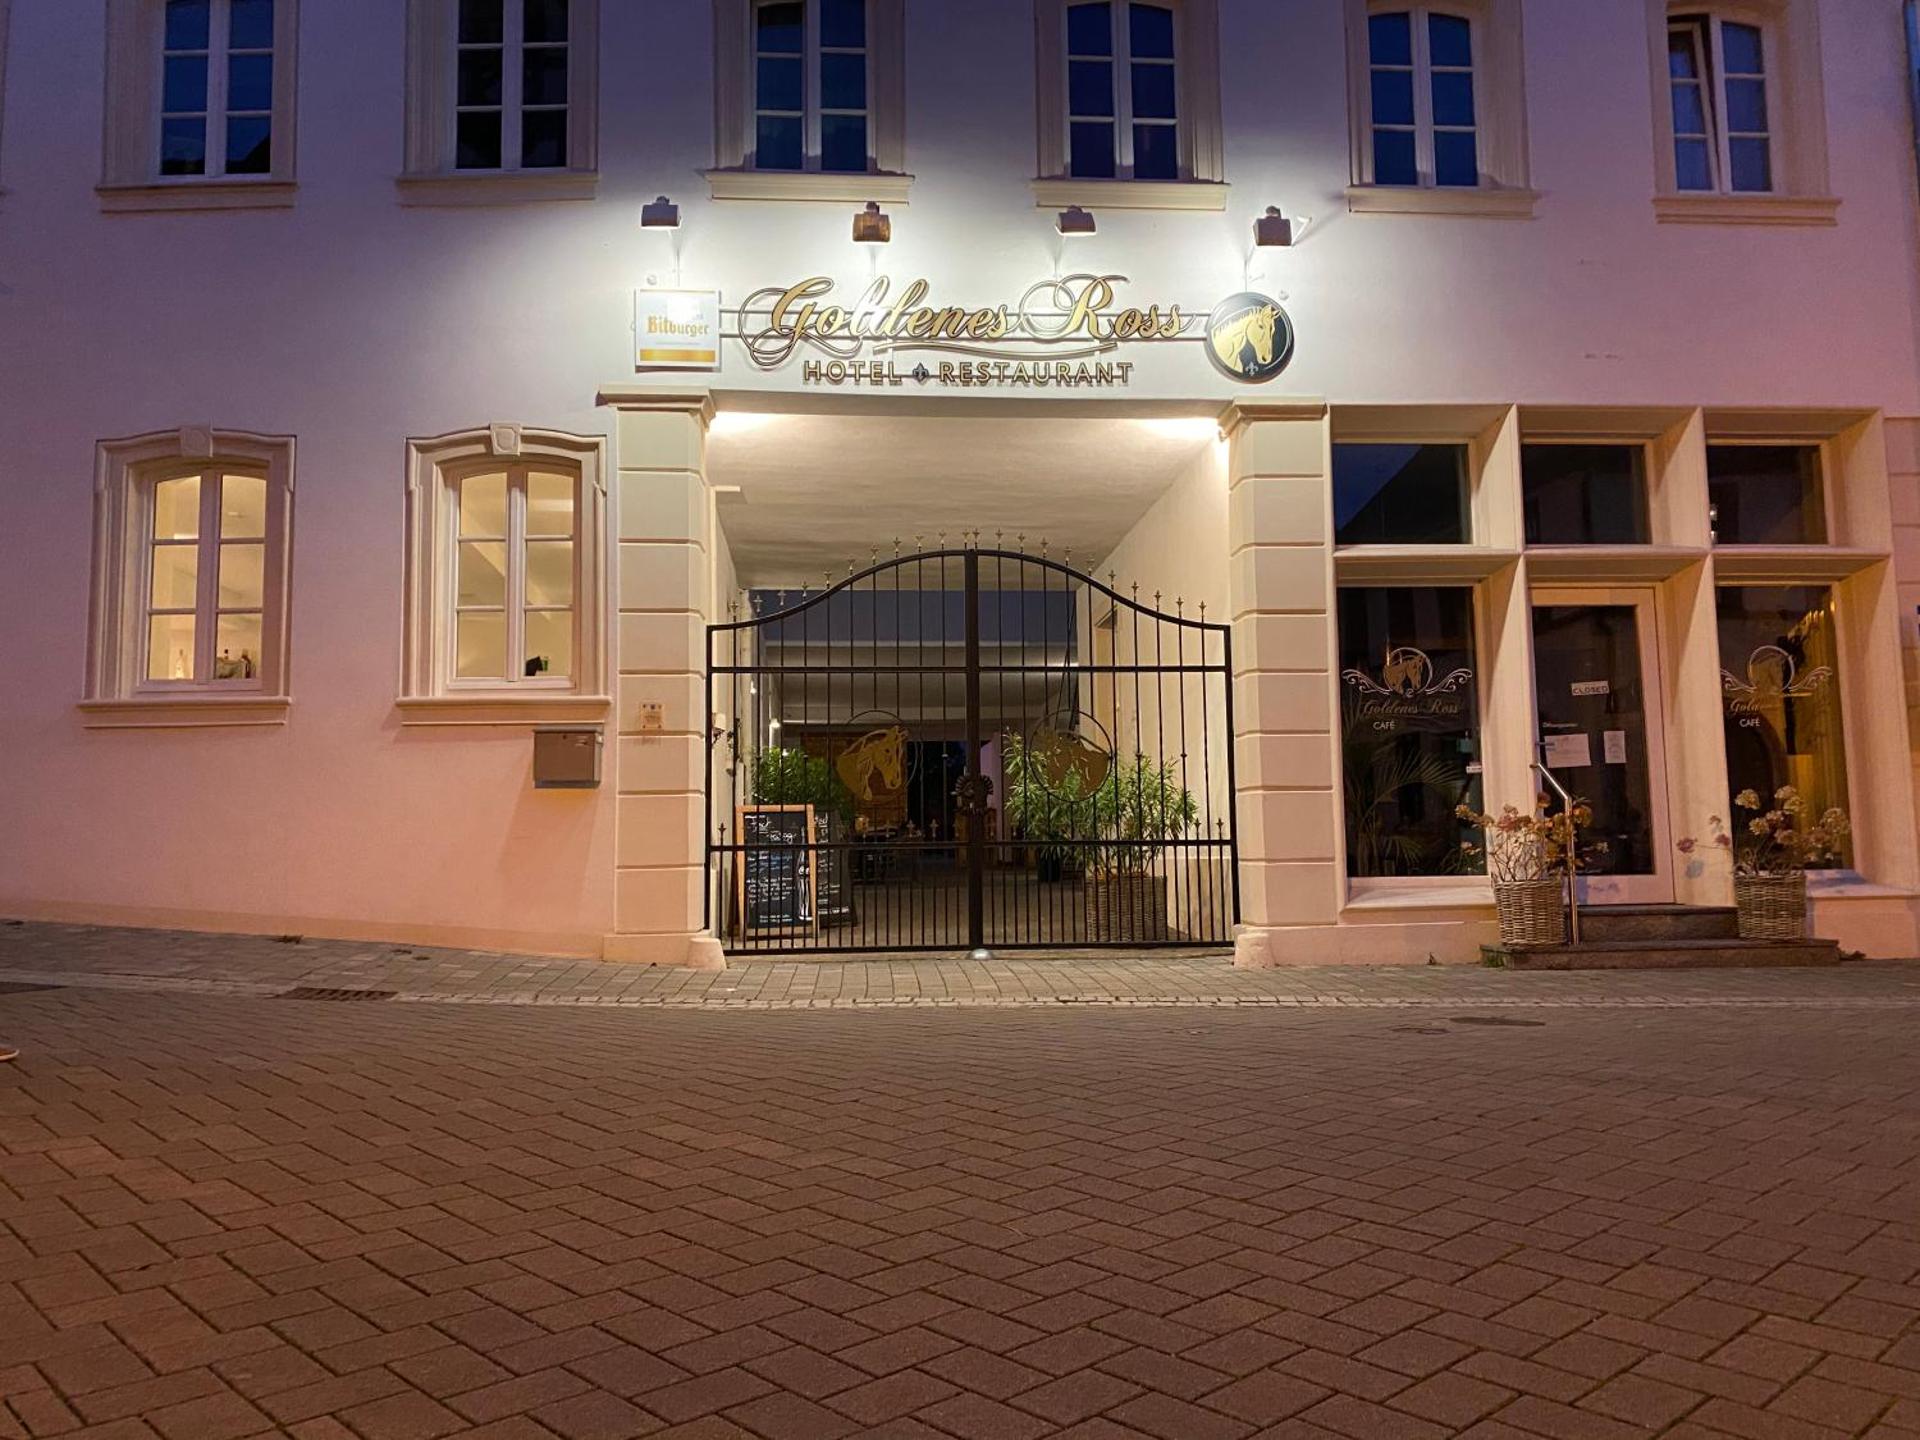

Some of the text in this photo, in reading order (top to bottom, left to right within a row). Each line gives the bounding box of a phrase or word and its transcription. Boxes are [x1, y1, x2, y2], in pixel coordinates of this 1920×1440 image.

[647, 315, 710, 338] Bitburger
[738, 274, 1197, 366] Goldenes Ross
[804, 360, 1134, 385] HOTEL RESTAURANT
[1572, 686, 1608, 695] CLOSED
[1362, 699, 1419, 718] Goldenes
[1372, 719, 1396, 731] CAFÉ
[1739, 717, 1761, 728] CAFÉ
